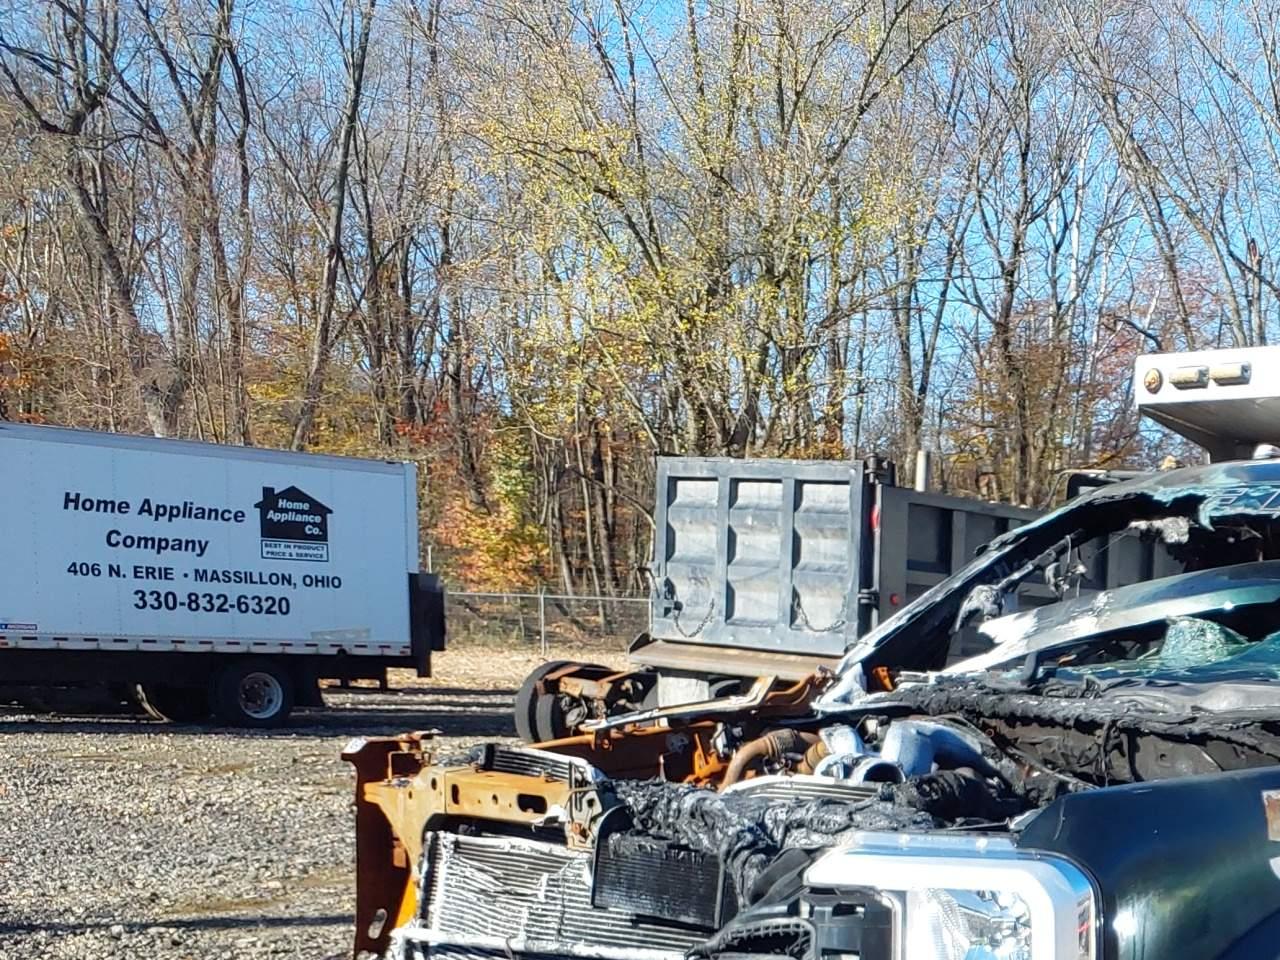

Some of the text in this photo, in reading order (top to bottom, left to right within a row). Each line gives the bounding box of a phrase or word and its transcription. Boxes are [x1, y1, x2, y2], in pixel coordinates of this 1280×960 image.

[63, 492, 246, 523] Home Appliance
[267, 510, 322, 523] Appliance
[278, 499, 310, 510] Home
[305, 525, 323, 535] Co.
[106, 529, 209, 557] Company
[67, 562, 342, 590] 406 N. ERIE MASSILLON, OHIO
[133, 590, 290, 615] 330-832-6320
